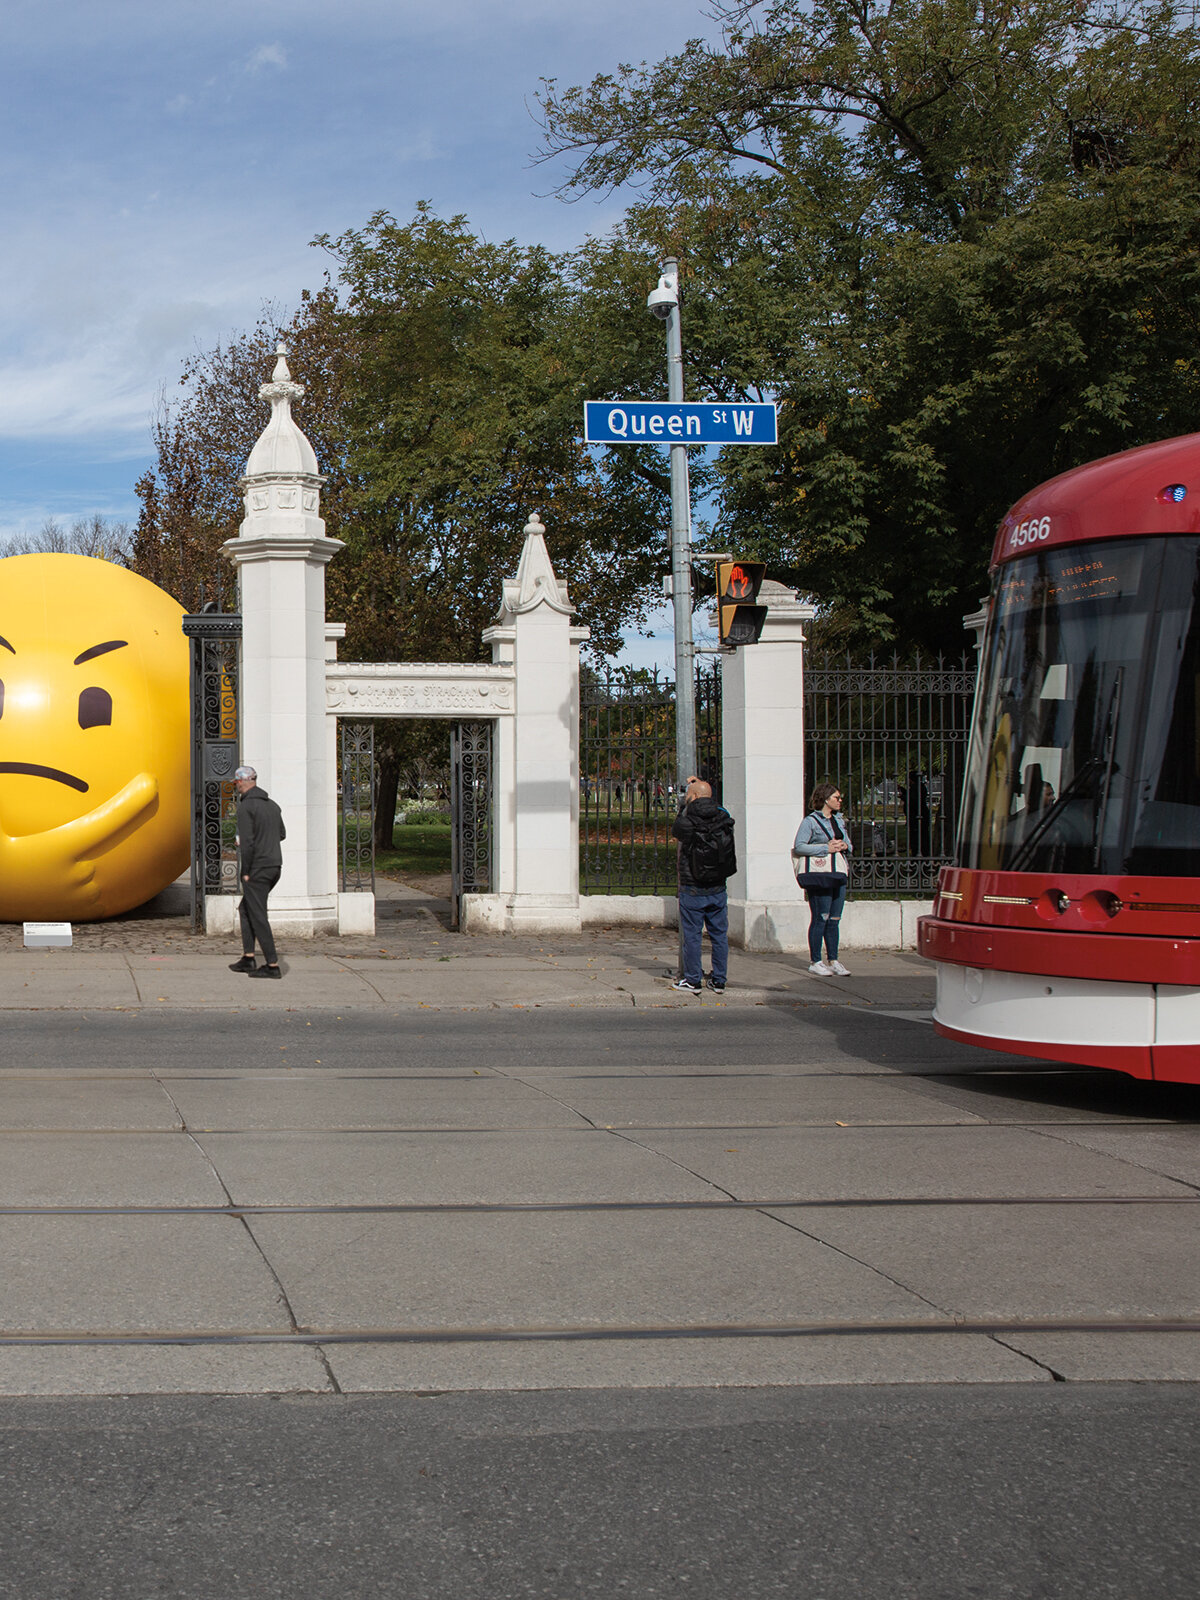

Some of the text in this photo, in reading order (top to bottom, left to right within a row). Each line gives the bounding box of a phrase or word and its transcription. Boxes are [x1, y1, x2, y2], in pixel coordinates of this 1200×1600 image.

[607, 408, 754, 438] Queen St W
[1010, 516, 1051, 547] 4566
